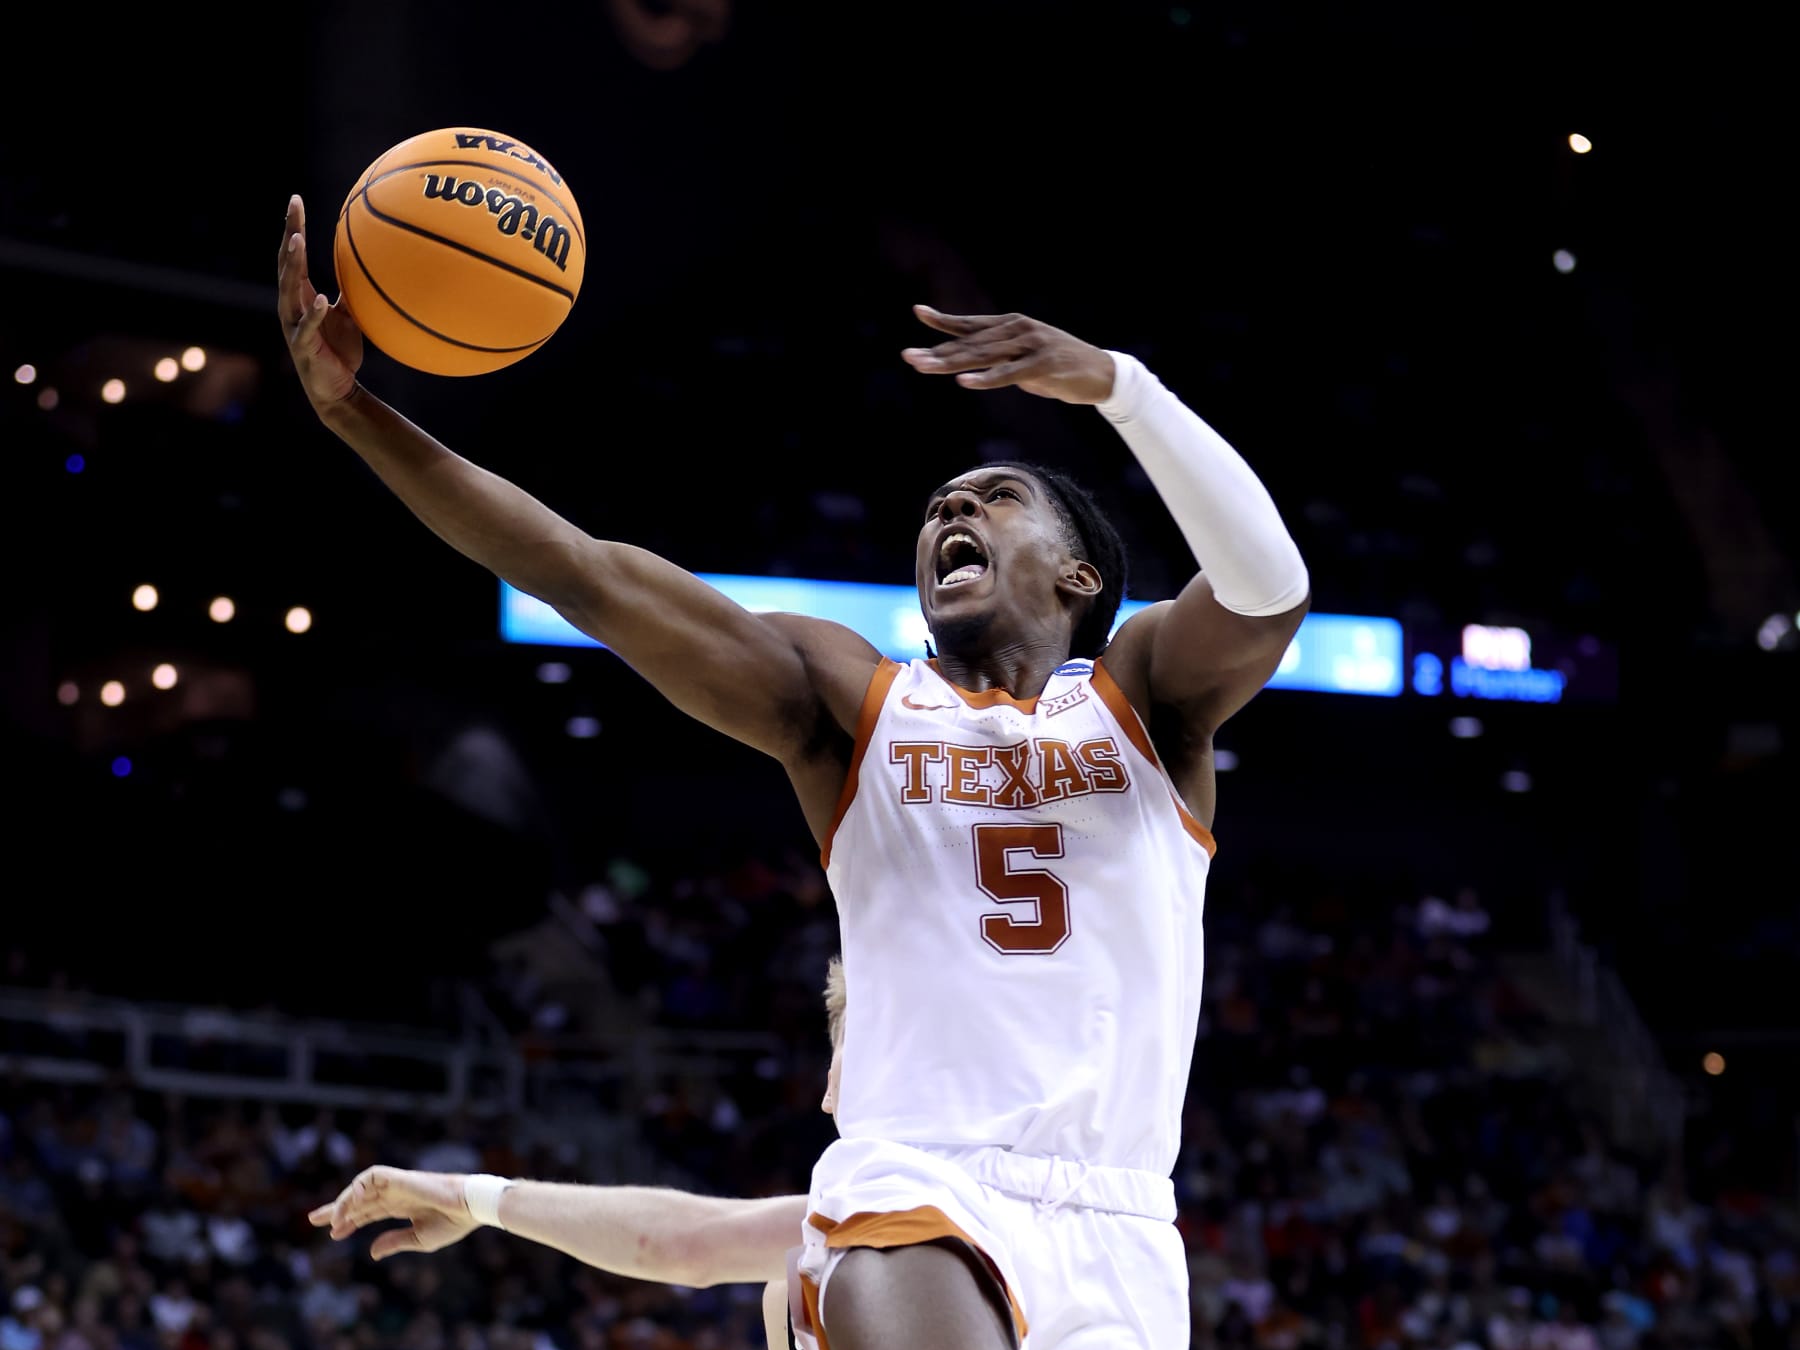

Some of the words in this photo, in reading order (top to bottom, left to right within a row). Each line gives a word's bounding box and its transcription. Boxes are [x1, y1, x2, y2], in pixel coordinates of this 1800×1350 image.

[455, 133, 562, 187] NCAA
[423, 173, 572, 272] Wilson
[889, 736, 1132, 810] TEXAS
[972, 823, 1072, 955] 5
